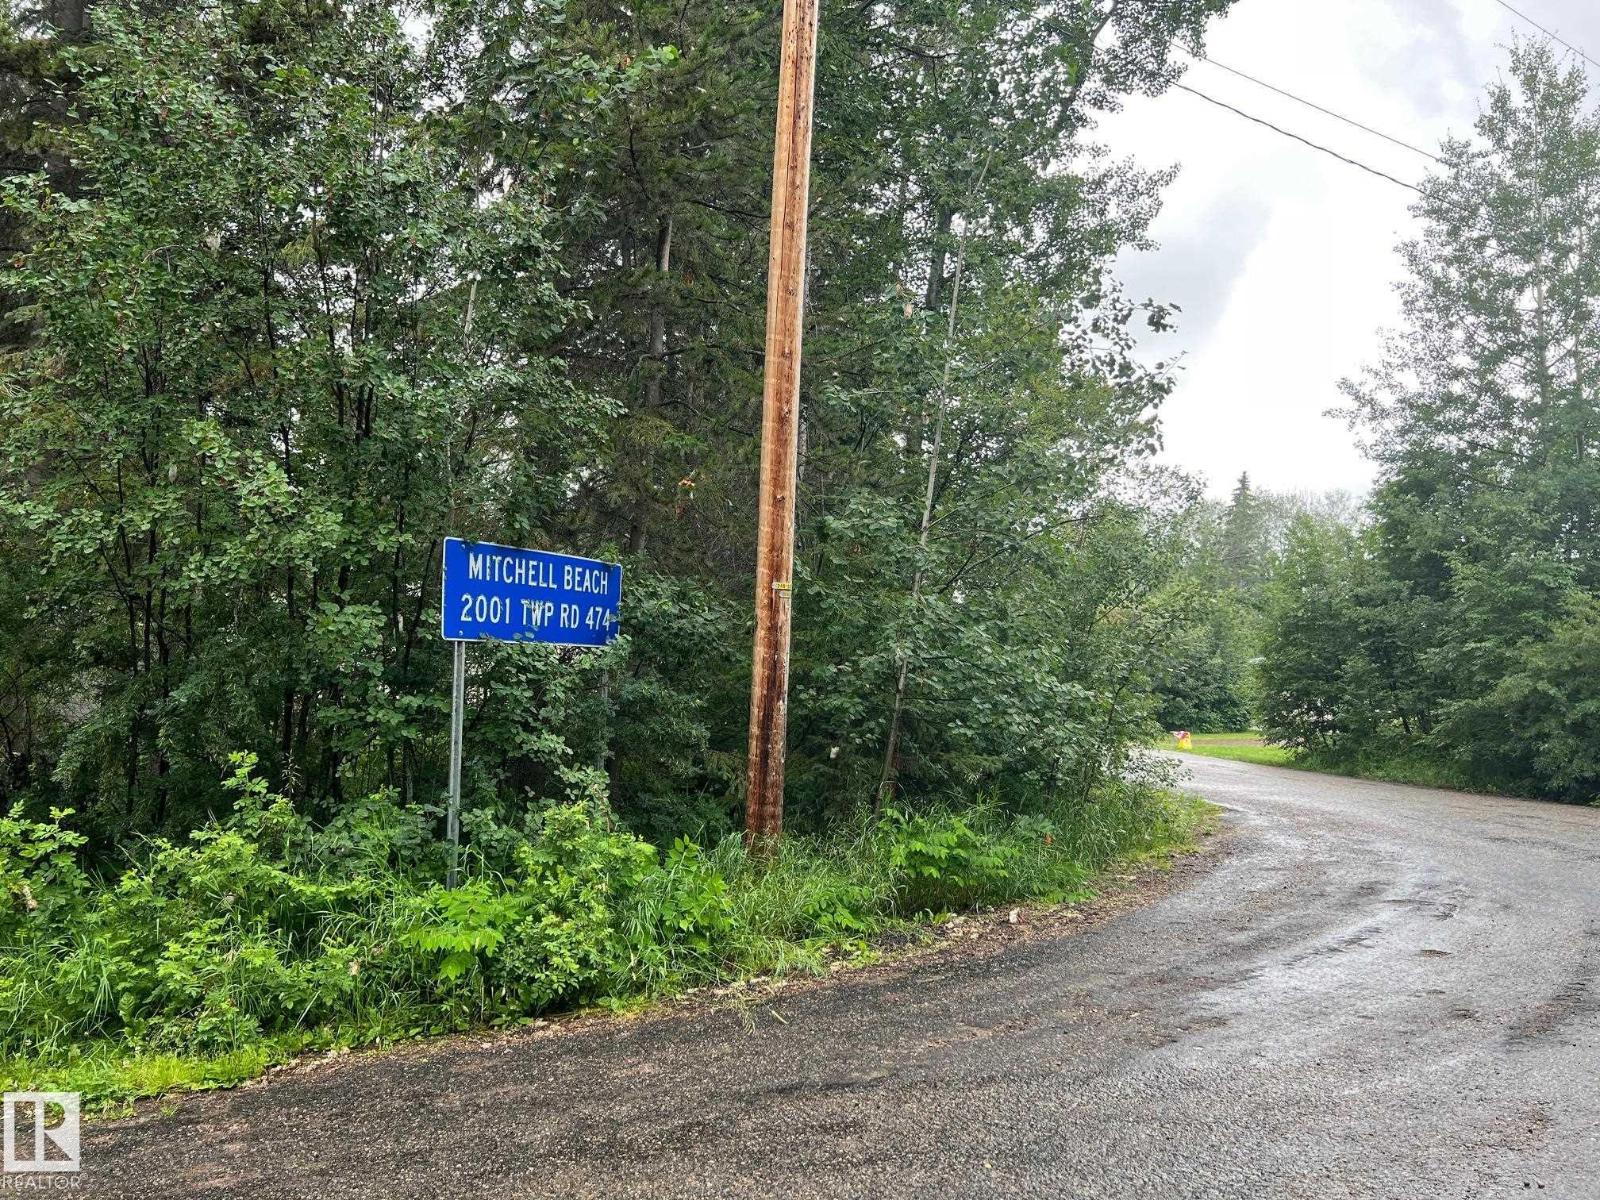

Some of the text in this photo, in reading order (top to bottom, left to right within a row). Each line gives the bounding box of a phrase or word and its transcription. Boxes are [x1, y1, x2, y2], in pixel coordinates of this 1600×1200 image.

[469, 552, 608, 595] MITCHELL BEACH
[461, 593, 611, 631] 2001 TWP RD 474
